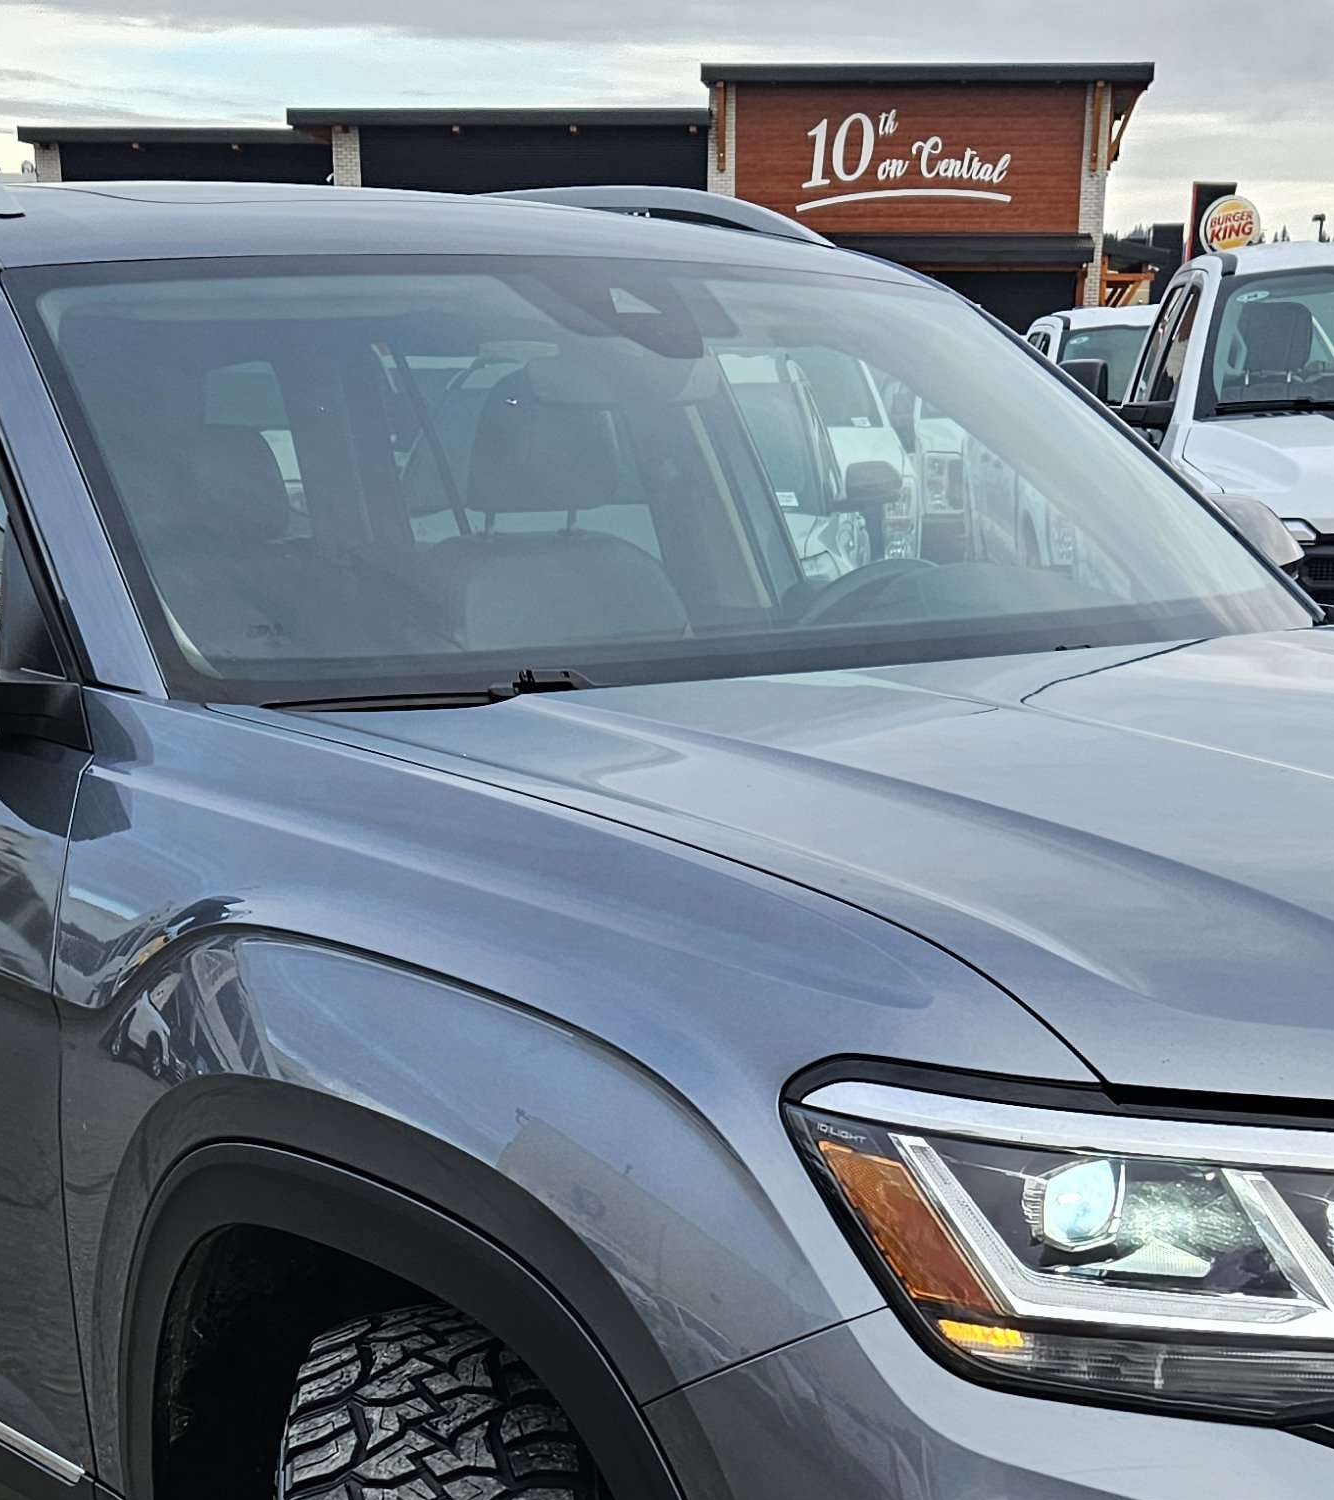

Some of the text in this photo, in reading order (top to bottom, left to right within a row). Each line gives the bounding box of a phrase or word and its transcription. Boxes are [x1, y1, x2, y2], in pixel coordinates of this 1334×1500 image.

[877, 158, 910, 181] on
[911, 136, 1012, 184] Central
[1210, 210, 1253, 227] BURGER
[1210, 221, 1253, 243] KING
